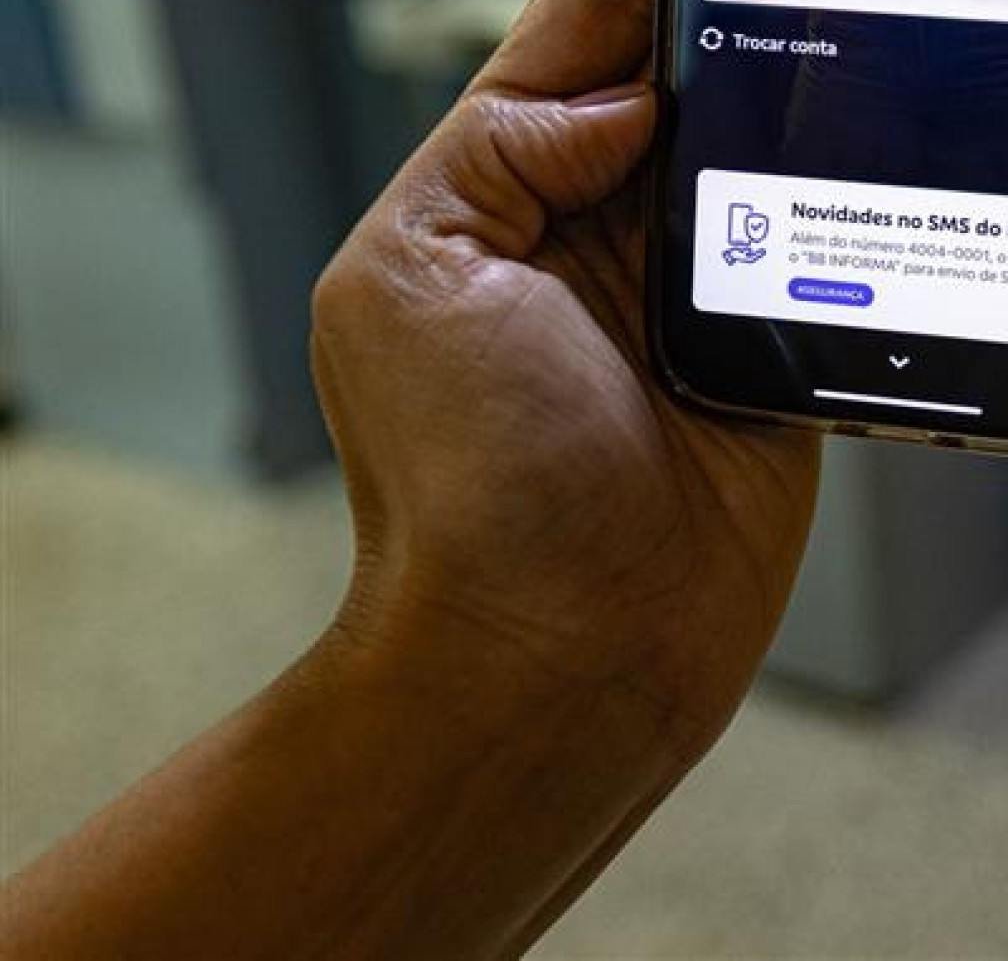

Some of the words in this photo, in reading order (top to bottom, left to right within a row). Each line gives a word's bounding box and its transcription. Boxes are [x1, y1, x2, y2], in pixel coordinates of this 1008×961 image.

[732, 31, 787, 52] Trocar
[790, 37, 838, 57] conta
[791, 201, 893, 227] Novidades
[897, 214, 923, 230] no
[928, 214, 971, 235] SMS
[975, 218, 1001, 237] do
[790, 231, 827, 246] Além
[829, 234, 848, 249] do
[851, 237, 905, 253] número
[998, 252, 1007, 264] o
[788, 252, 799, 264] o
[904, 262, 935, 278] para
[937, 265, 976, 281] envio
[979, 268, 998, 282] de
